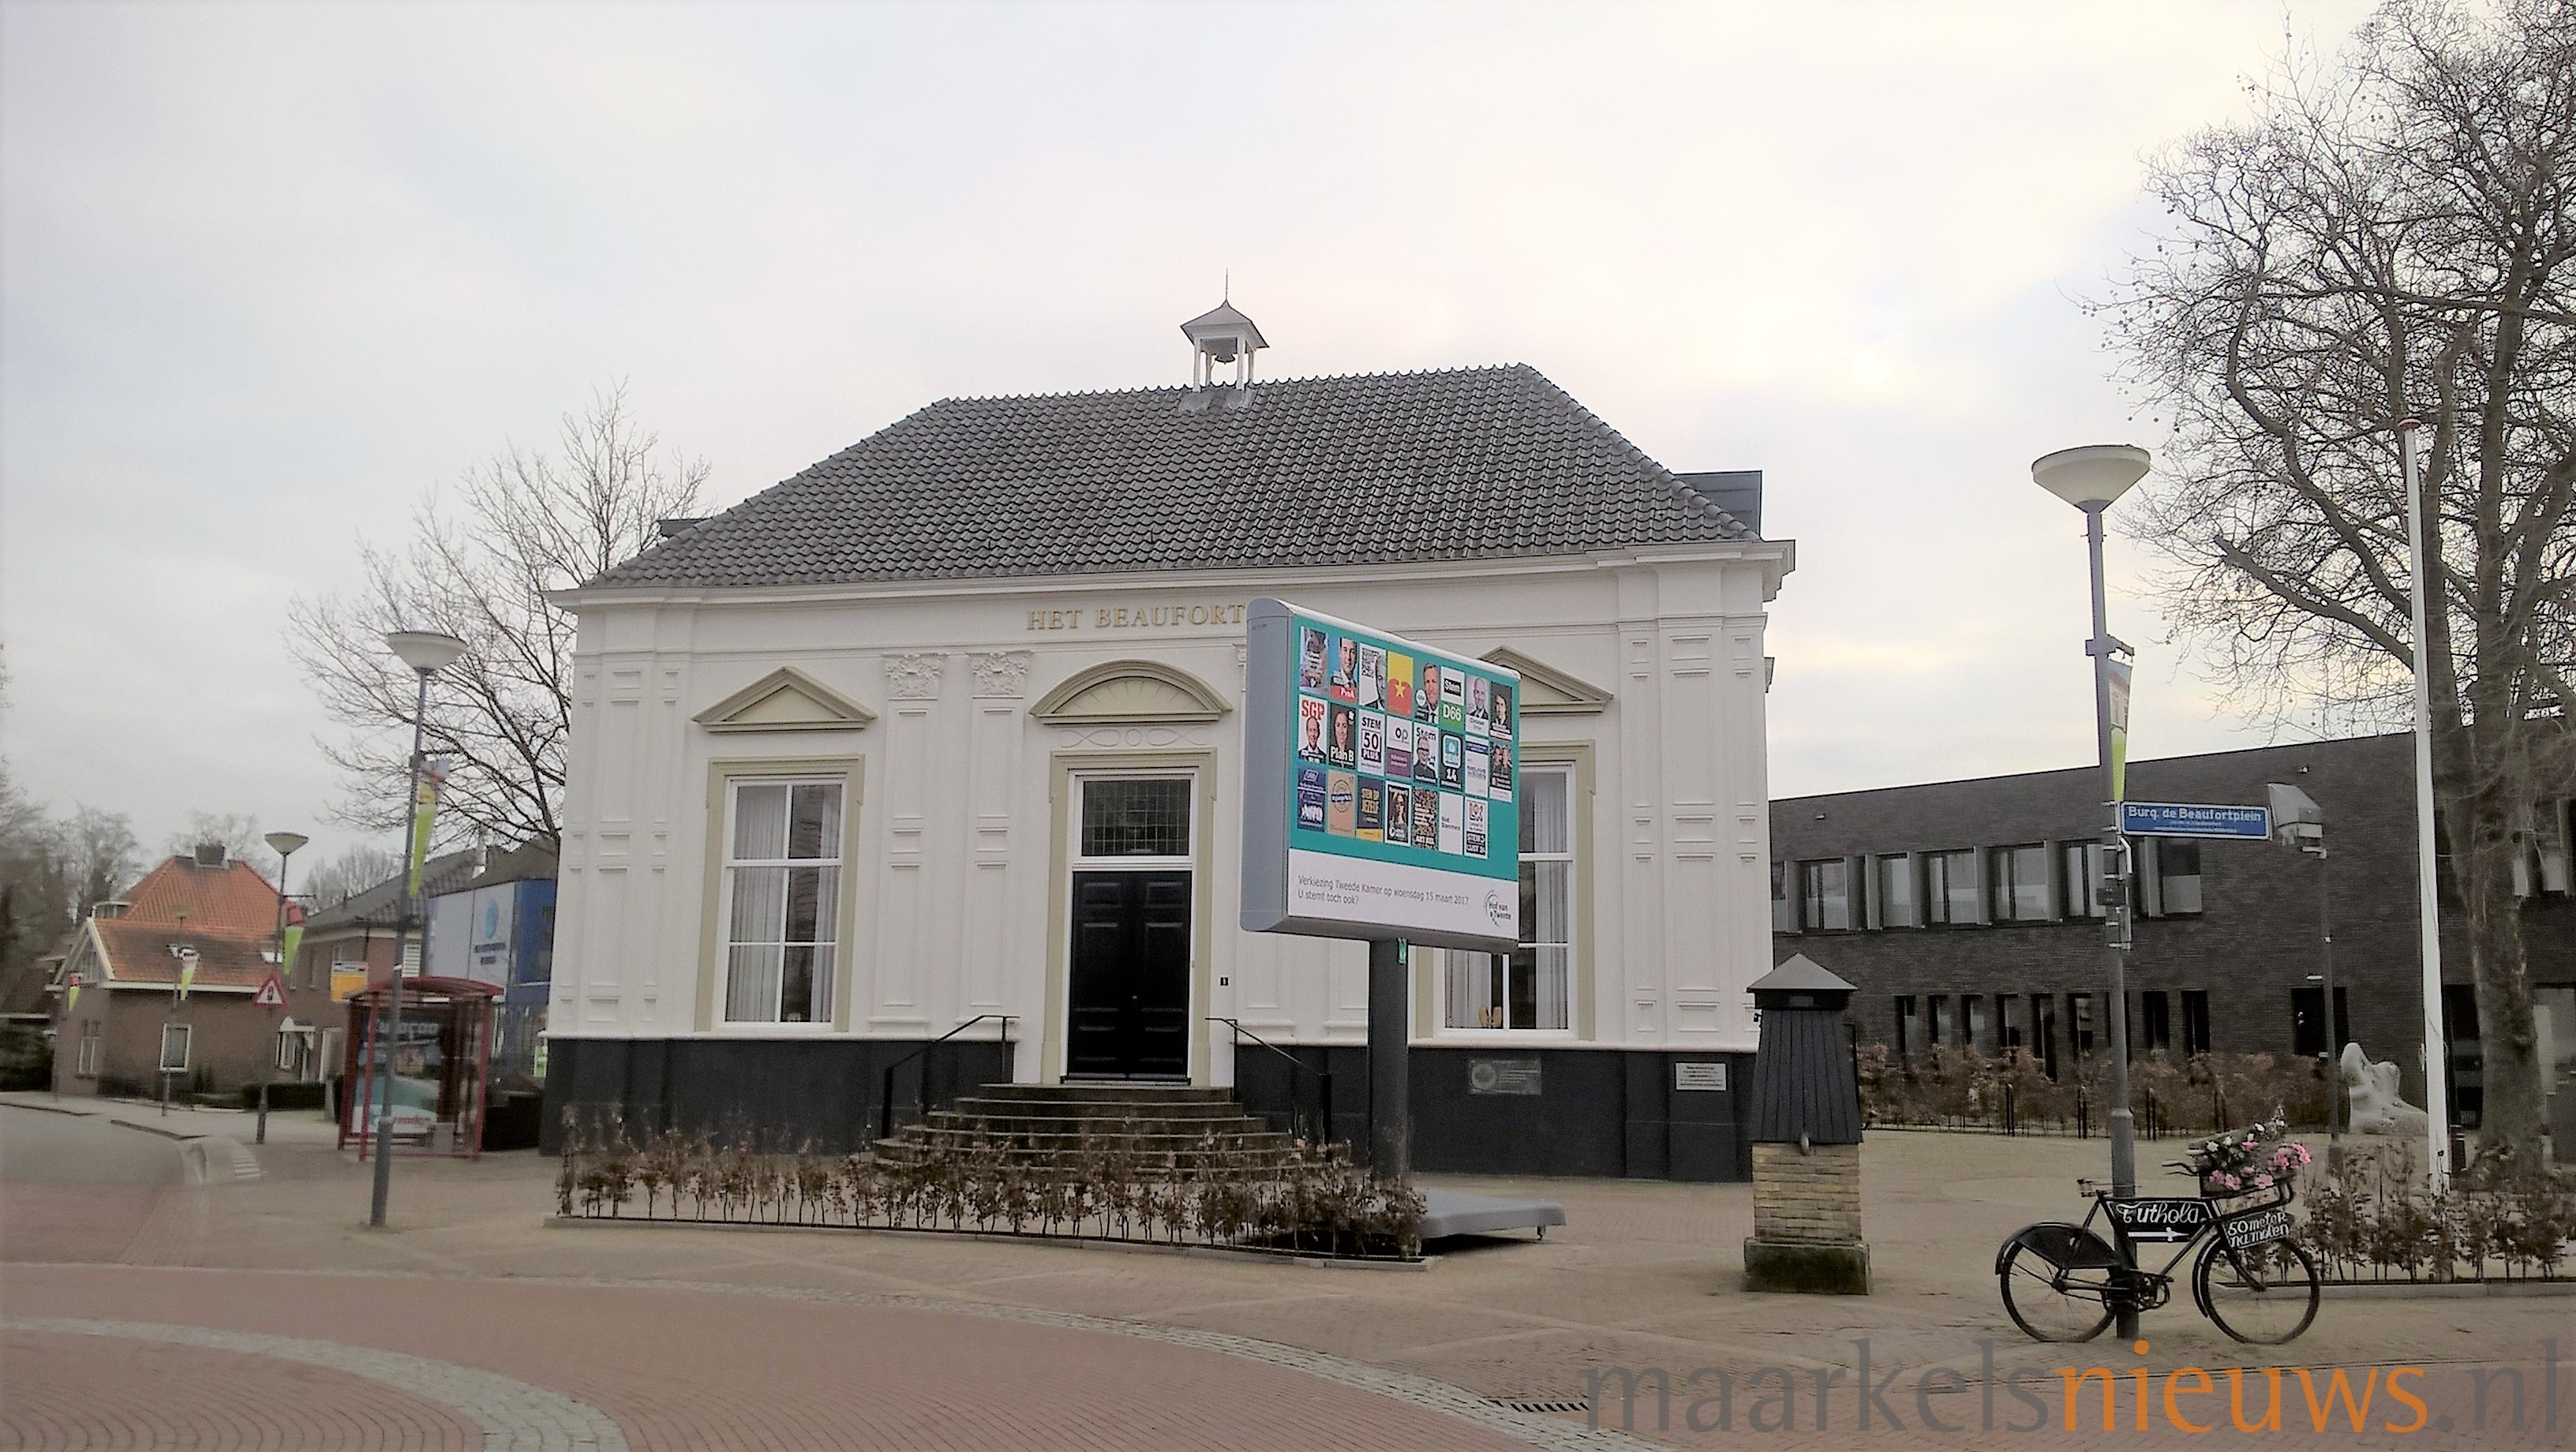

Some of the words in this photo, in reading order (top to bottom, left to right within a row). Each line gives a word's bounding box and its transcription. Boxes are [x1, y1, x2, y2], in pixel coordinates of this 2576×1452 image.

[1027, 608, 1082, 630] HET
[1095, 602, 1245, 629] BEAUFORT
[1301, 699, 1325, 720] SGP
[1443, 703, 1462, 722] D66
[1361, 717, 1382, 730] STEM
[1363, 732, 1380, 750] 50
[1348, 749, 1355, 762] B
[2162, 808, 2177, 818] de
[2179, 808, 2262, 821] Beaufortplein
[1297, 889, 1304, 898] U
[1305, 890, 1325, 900] stemt
[1327, 893, 1342, 903] toch
[1343, 894, 1359, 905] ook?
[1298, 875, 1333, 890] Verkiezing
[1335, 880, 1360, 892] Tweede
[1361, 883, 1383, 894] Kamer
[1383, 887, 1392, 897] op
[1394, 889, 1424, 901] woensdag
[1426, 892, 1433, 900] 15
[1435, 893, 1453, 903] maart
[1455, 896, 1470, 905] 2017
[2227, 1220, 2248, 1237] 50
